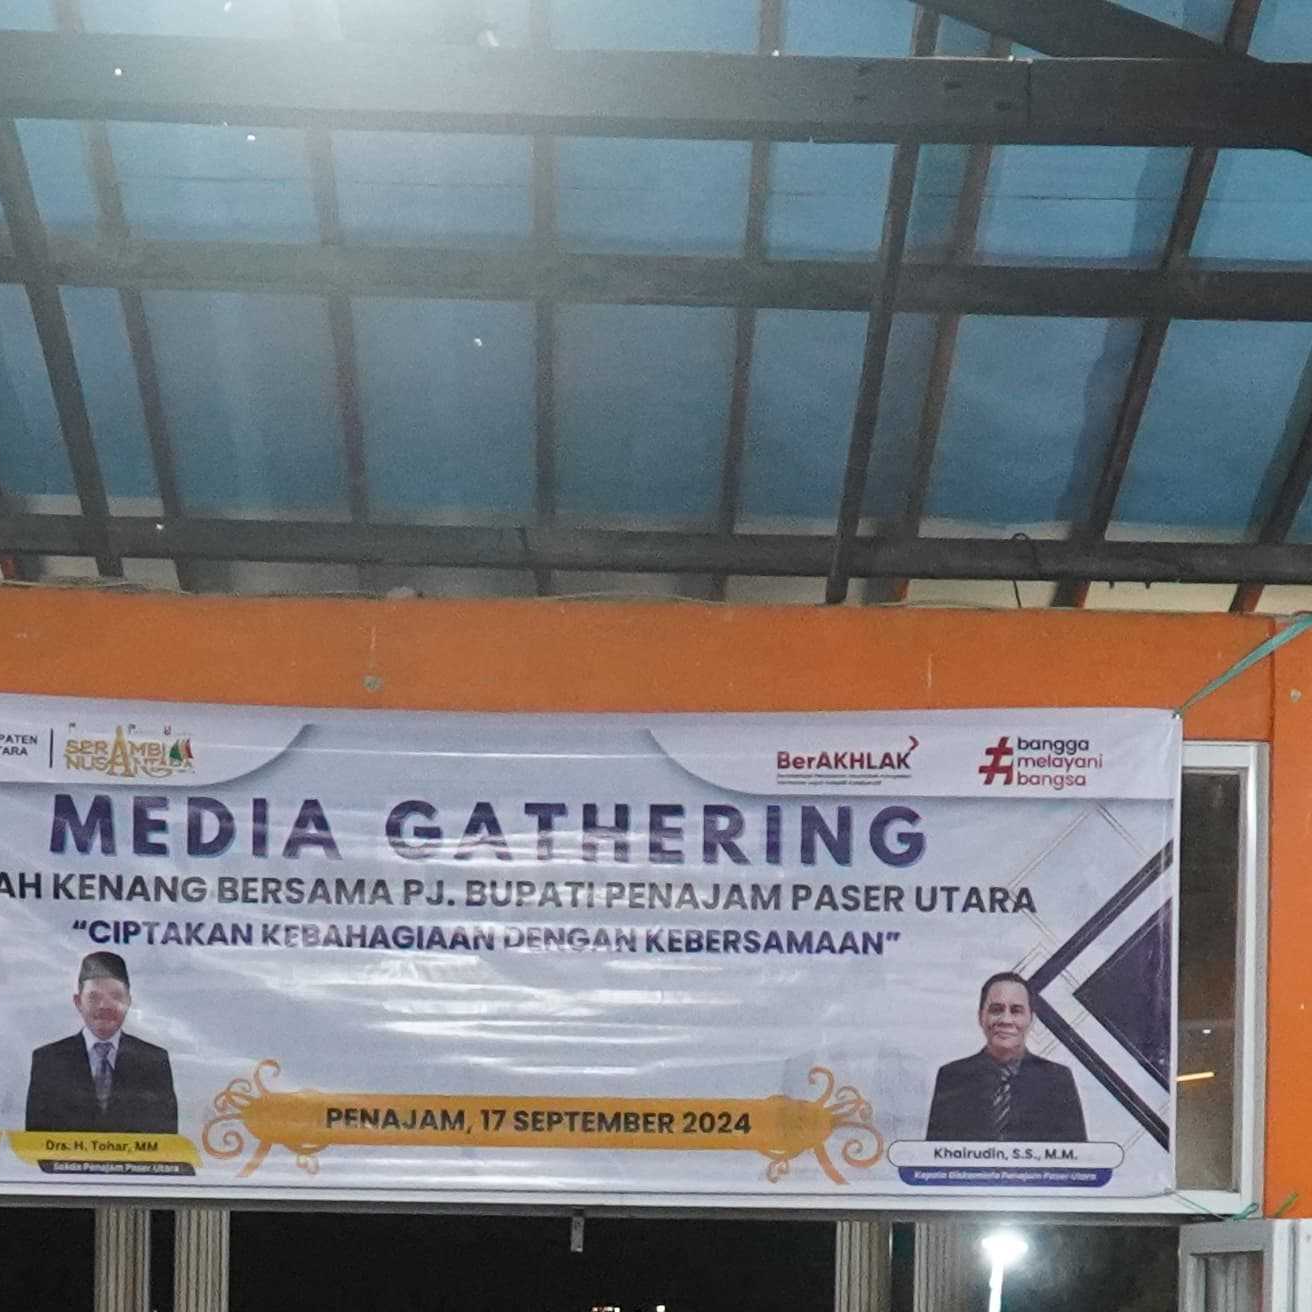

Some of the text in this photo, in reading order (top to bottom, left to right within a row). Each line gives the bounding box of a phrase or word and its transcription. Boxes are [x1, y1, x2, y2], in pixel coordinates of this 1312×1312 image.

[1017, 737, 1090, 755] bangga
[777, 750, 912, 770] BerAKHLAK
[1017, 754, 1104, 772] melayani
[1017, 771, 1087, 791] bangsa
[49, 793, 927, 867] MEDIA GATHERING
[52, 873, 208, 903] KENANG
[217, 876, 395, 906] BERSAMA
[402, 879, 457, 907] PJ.
[464, 879, 596, 908] BUPATI
[606, 881, 783, 911] PENAJAM
[791, 884, 906, 912] PASER
[915, 885, 1038, 914] UTARA
[261, 921, 495, 951] KEBAHAGIAAN
[503, 926, 637, 953] DENGAN
[325, 1107, 752, 1135] PENAJAM, 17 SEPTEMBER 2024
[45, 1139, 159, 1154] Drs. H. Tohar, MM
[933, 1147, 1009, 1161] Khairudin,
[1044, 1148, 1078, 1161] M.M.
